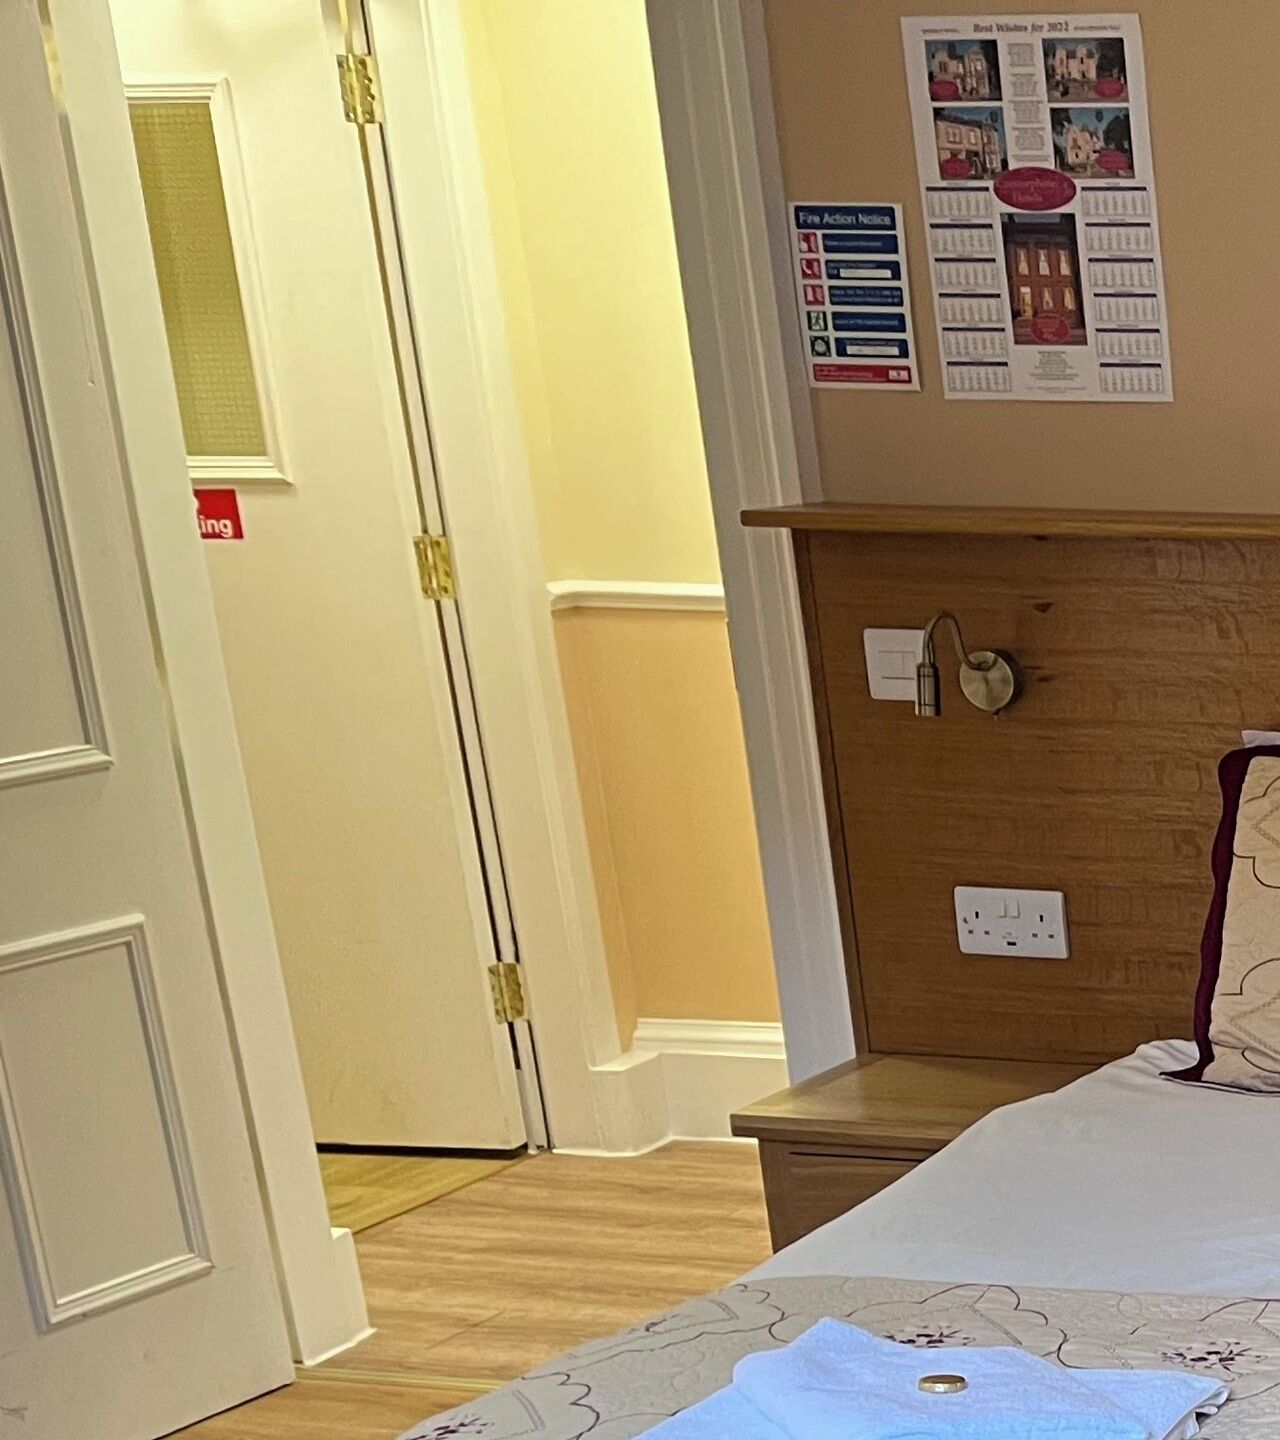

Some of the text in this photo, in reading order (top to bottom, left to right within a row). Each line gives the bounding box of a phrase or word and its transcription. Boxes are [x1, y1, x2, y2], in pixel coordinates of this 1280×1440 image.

[973, 23, 993, 32] Best
[995, 23, 1028, 32] Wishes
[1031, 23, 1044, 35] for
[799, 212, 891, 225] Fire Action Notice
[198, 515, 233, 538] ing
